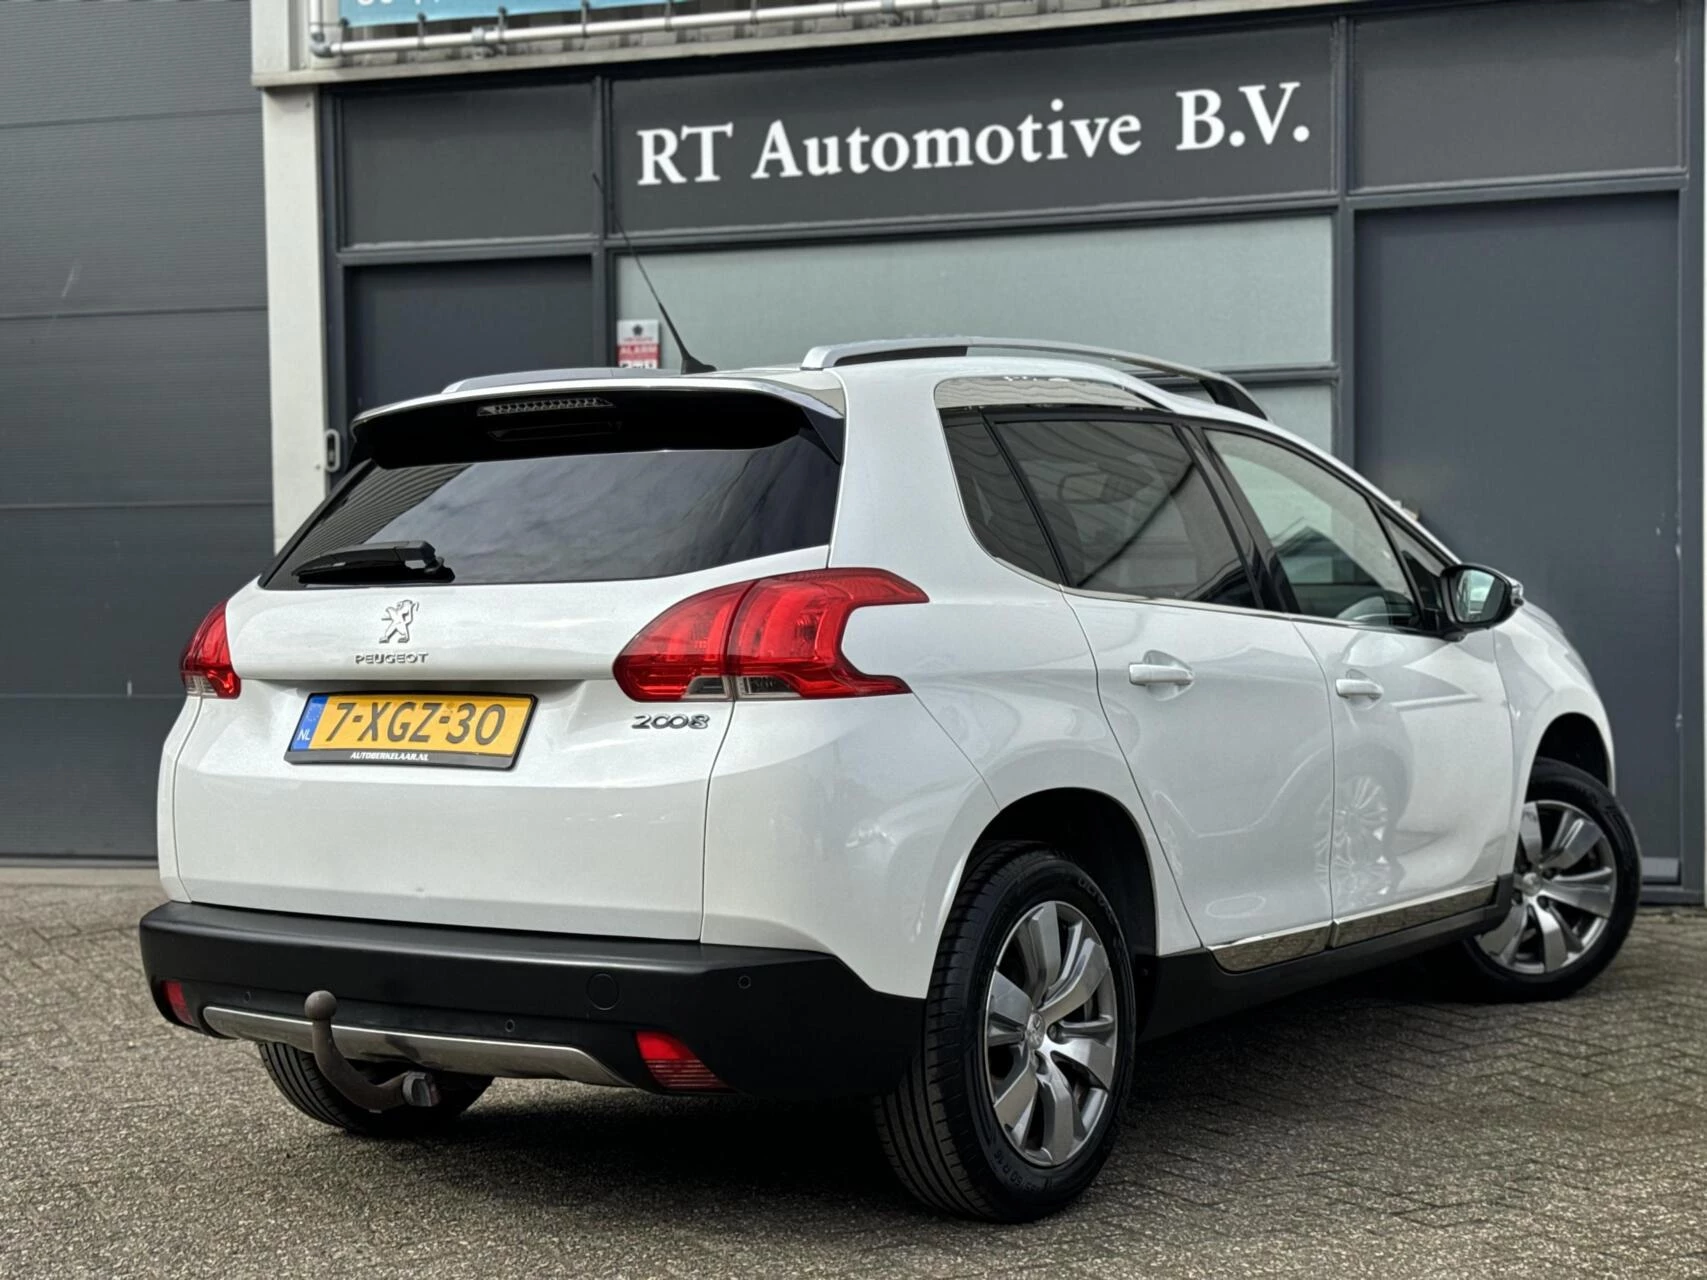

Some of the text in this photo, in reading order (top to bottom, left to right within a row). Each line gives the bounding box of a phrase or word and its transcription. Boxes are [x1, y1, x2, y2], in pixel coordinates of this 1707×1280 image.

[637, 81, 1310, 186] RT Automotive B.V.
[355, 652, 430, 665] PEUGEOT
[325, 702, 507, 747] 7-XGZ-30
[631, 713, 711, 730] 2008
[298, 728, 312, 742] NL
[350, 751, 430, 762] AUTOBERKELAAR.NL
